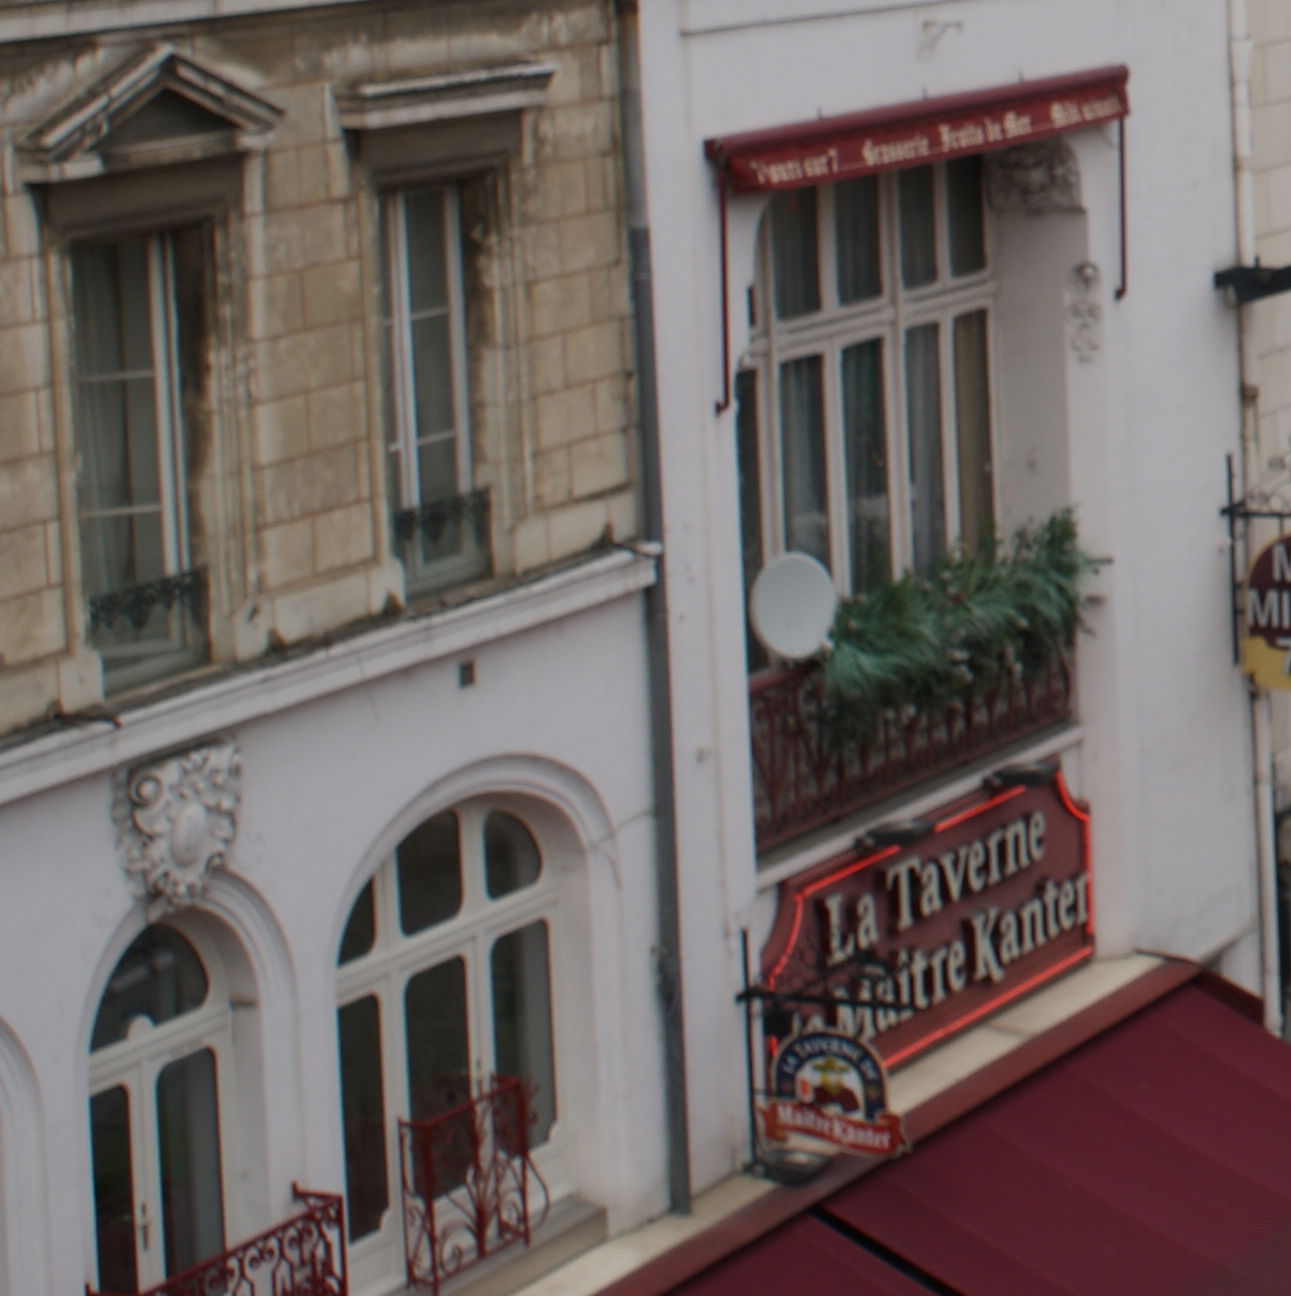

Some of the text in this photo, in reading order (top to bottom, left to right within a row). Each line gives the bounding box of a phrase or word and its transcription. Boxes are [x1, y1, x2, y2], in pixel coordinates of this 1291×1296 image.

[823, 811, 1047, 966] La Taverne
[971, 872, 1089, 984] Kanter
